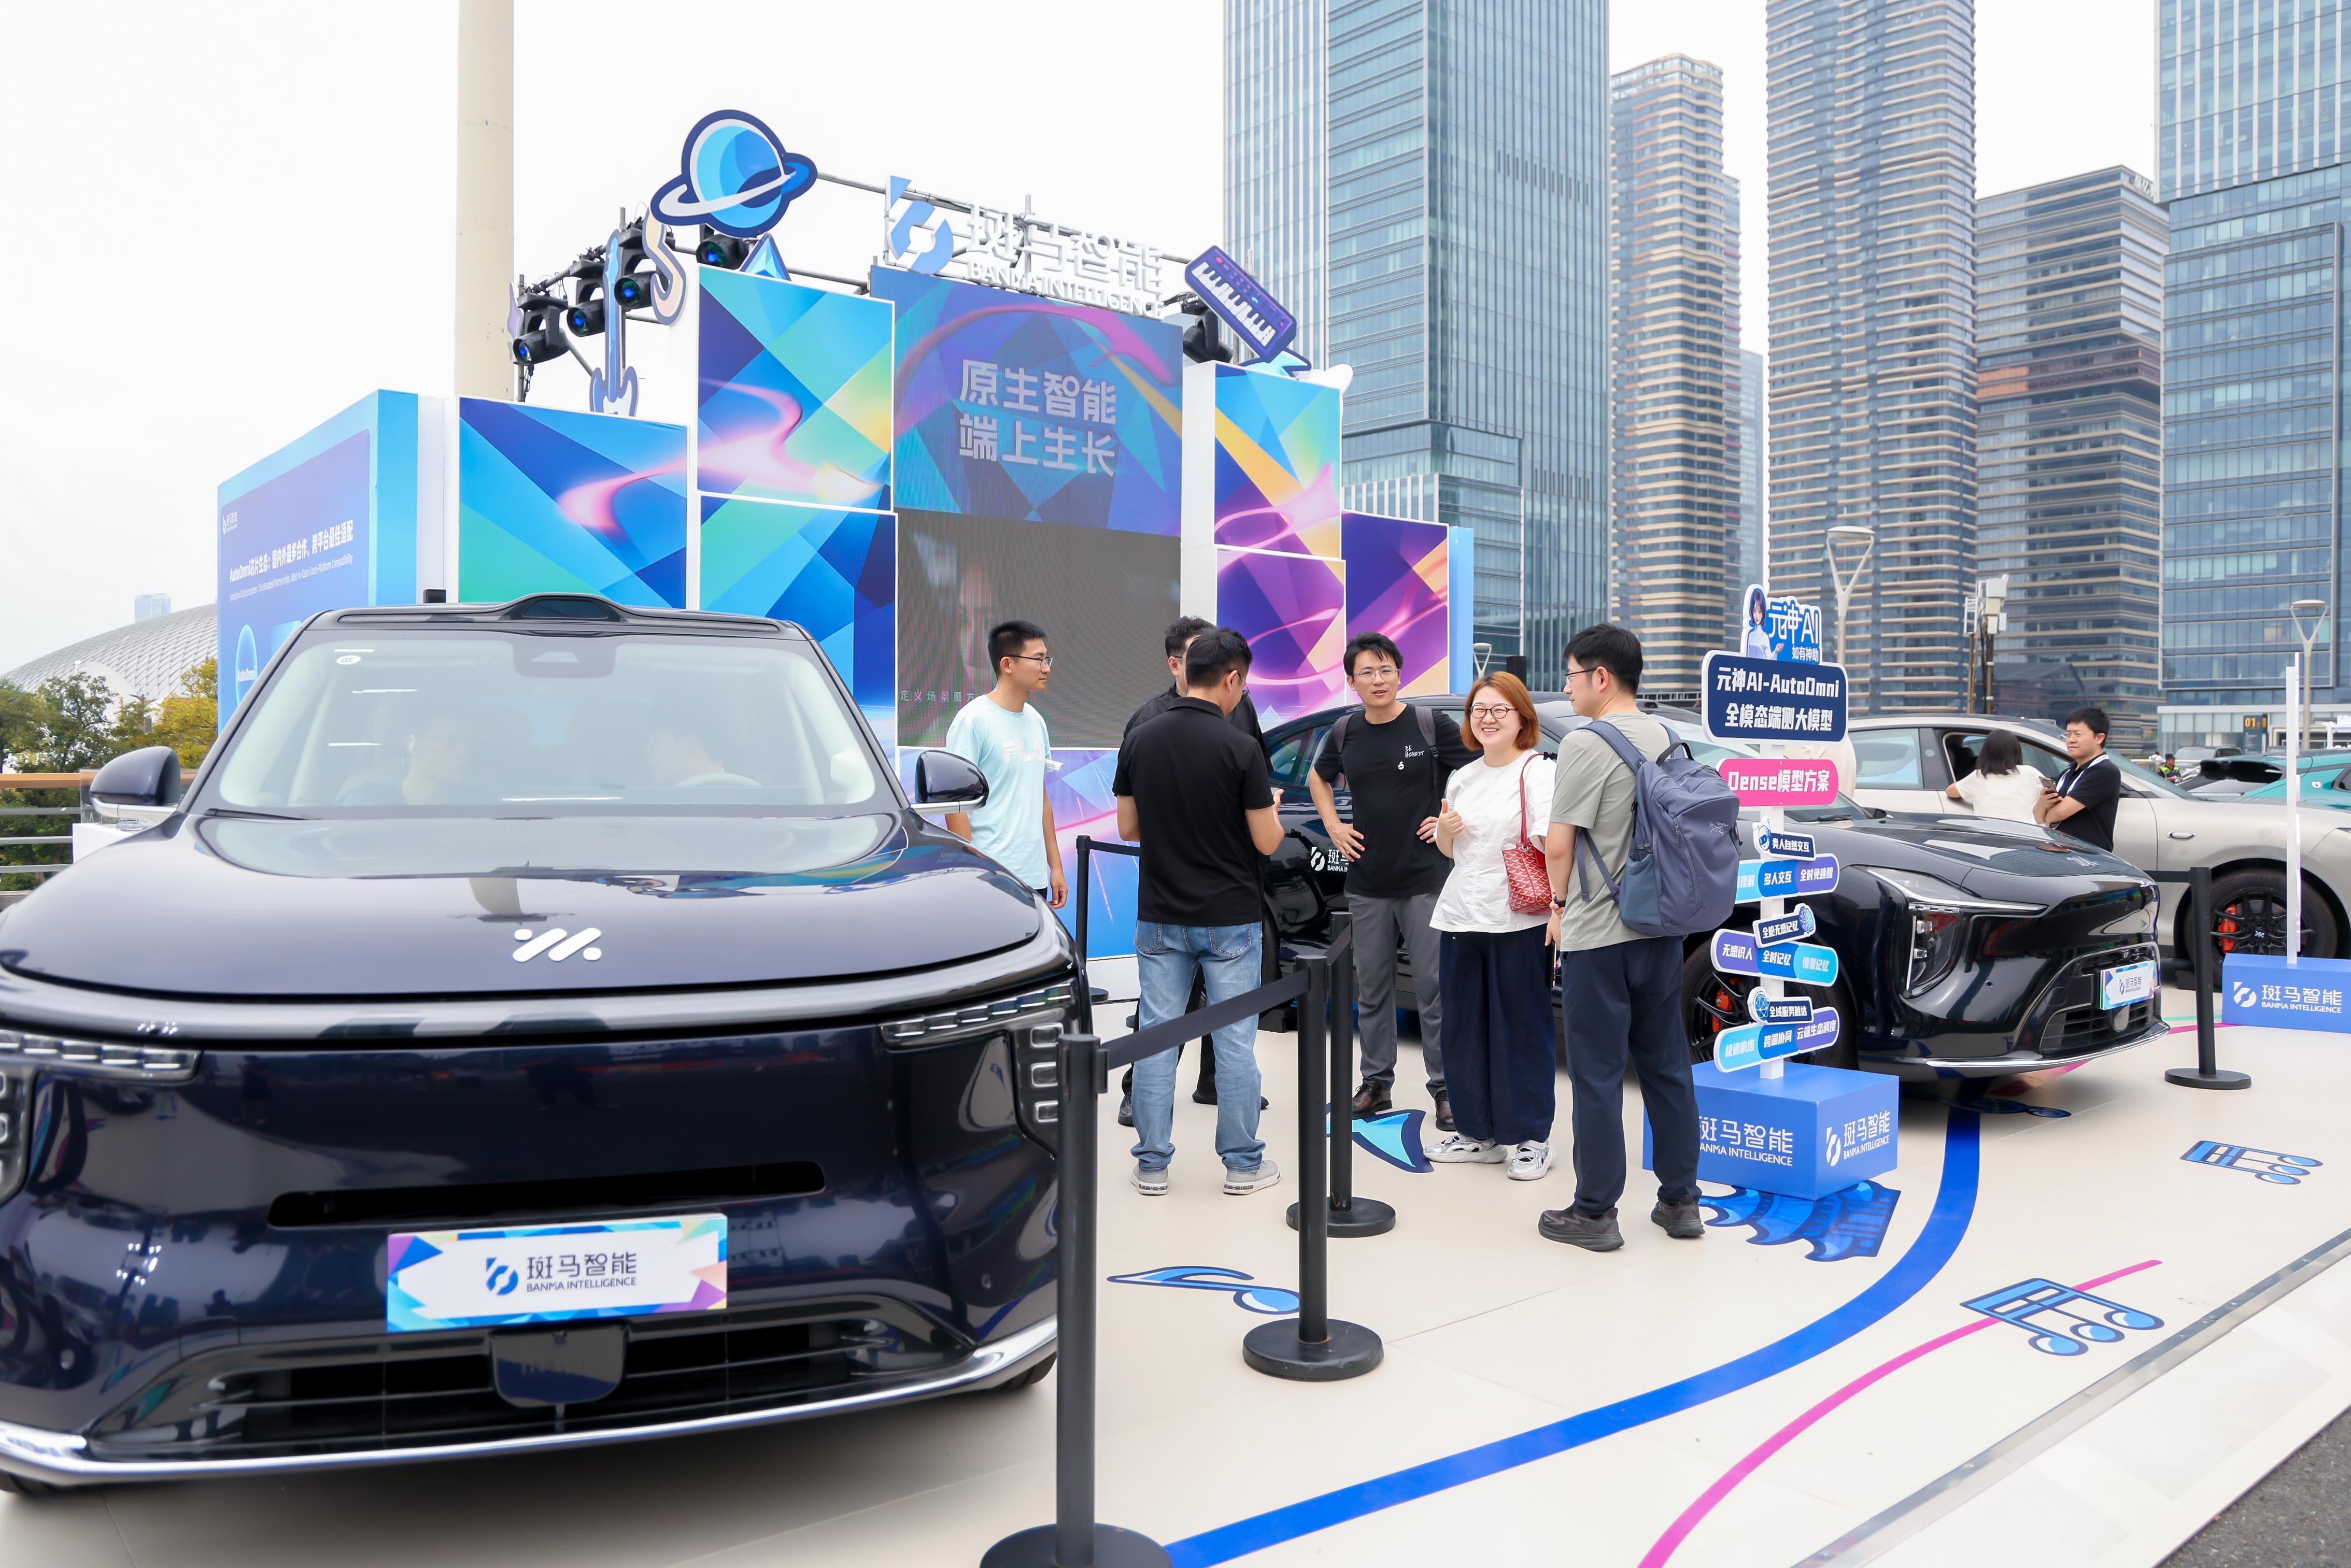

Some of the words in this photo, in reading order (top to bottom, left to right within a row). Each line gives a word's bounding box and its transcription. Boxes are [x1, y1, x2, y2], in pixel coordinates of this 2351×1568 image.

[966, 201, 1163, 294] 斑马智能
[967, 260, 1039, 291] BANMA
[1041, 278, 1163, 320] INTELLIGENCE
[960, 359, 1116, 424] 原生智能
[959, 413, 1115, 477] 端上生长
[1768, 603, 1818, 645] 元神AI
[1792, 645, 1819, 662] 如有神助
[1716, 666, 1839, 698] 元神AI-AutoOmni
[1724, 702, 1833, 731] 全模态端侧大模型
[1405, 745, 1412, 753] BE
[1727, 769, 1830, 792] Dense模型方案
[1772, 837, 1810, 852] 类人自然交互
[1763, 871, 1793, 886] 多人交互
[1800, 866, 1834, 882] 全时免唤醒
[1762, 920, 1800, 939] 全舱无感记忆
[1722, 943, 1753, 961] 无感识人
[1762, 950, 1792, 966] 全时记忆
[1802, 956, 1830, 972] 情景记忆
[2261, 985, 2343, 1006] 斑马智能
[2261, 1001, 2289, 1009] BANMA
[2290, 1003, 2342, 1014] INTELLIGENCE
[1769, 1005, 1808, 1018] 全域服务触达
[1724, 1039, 1755, 1058] 极速响应
[1763, 1030, 1793, 1049] 跨端协同
[1796, 1019, 1837, 1040] 云端生态调度
[1844, 1110, 1890, 1147] 斑马智能
[1699, 1142, 1727, 1156] ANMA
[1729, 1147, 1793, 1166] INTELLIGENCE
[1843, 1146, 1860, 1160] BANMA
[1860, 1134, 1890, 1153] INTELLIGENCE
[527, 1251, 636, 1280] 斑马智能
[527, 1281, 564, 1292] BANMA
[566, 1276, 636, 1289] INTELLIGENCE
